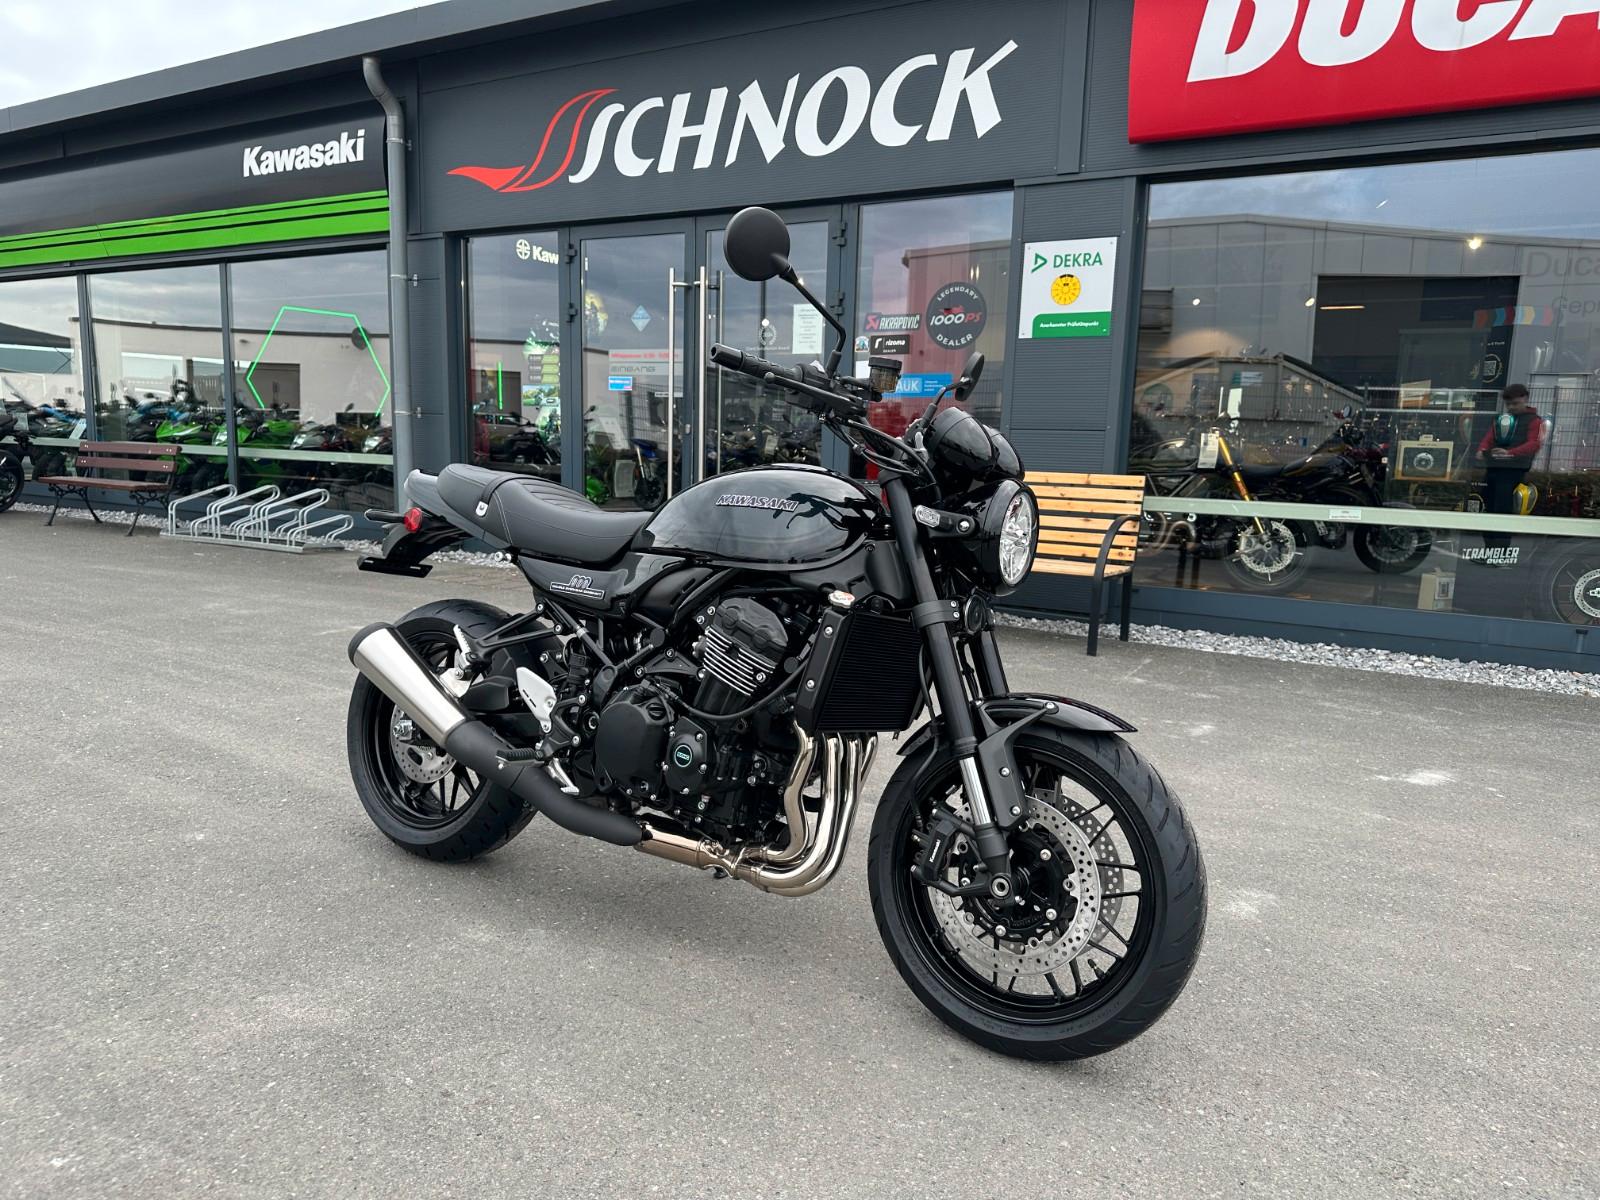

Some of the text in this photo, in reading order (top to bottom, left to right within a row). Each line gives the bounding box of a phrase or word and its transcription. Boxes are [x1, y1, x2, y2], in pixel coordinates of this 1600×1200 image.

[568, 40, 1019, 184] SCHNOCK
[243, 129, 365, 177] Kawasaki
[1053, 251, 1103, 268] DEKRA
[936, 286, 979, 302] LEGENDARY
[885, 338, 906, 346] rizoma
[936, 333, 974, 347] DEALER
[715, 494, 799, 512] KAWASAKI
